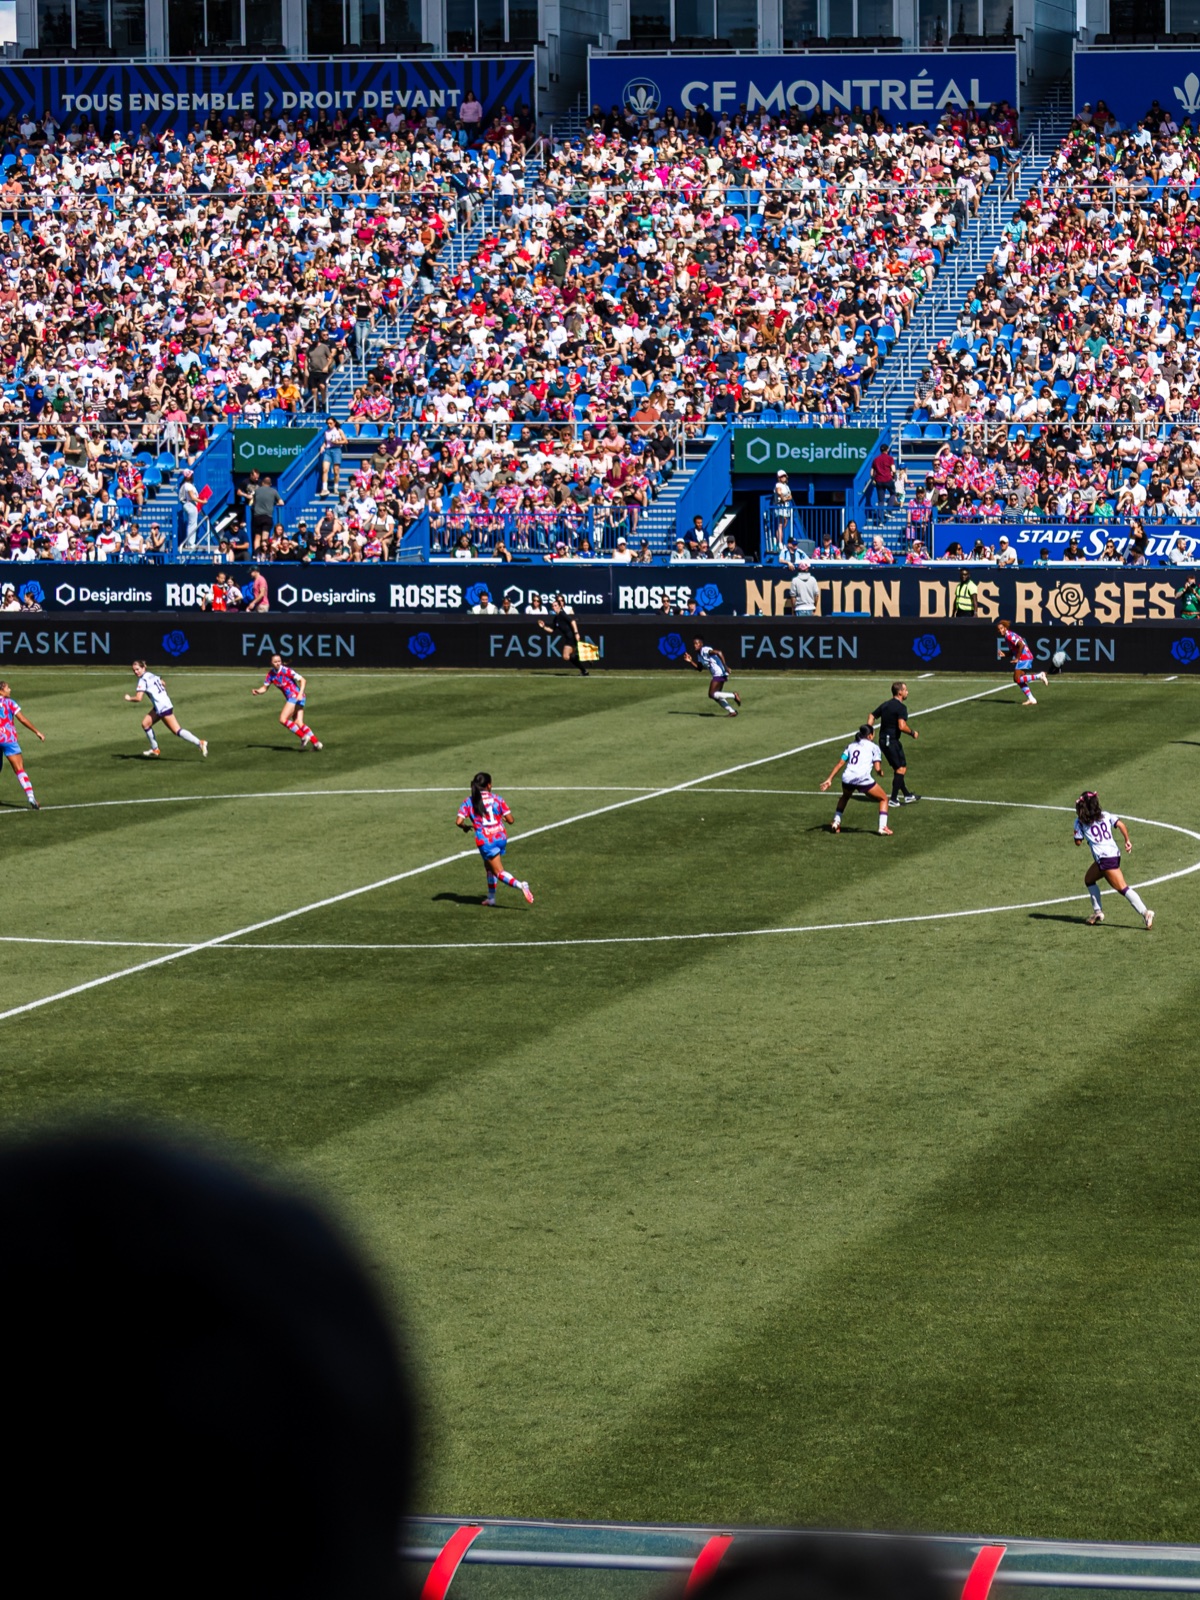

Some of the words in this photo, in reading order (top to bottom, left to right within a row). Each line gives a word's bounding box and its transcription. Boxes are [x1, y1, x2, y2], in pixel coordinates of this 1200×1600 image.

[282, 91, 357, 109] DROIT
[363, 89, 462, 109] DEVANT
[680, 81, 737, 112] CF
[746, 68, 992, 112] MONTRÉAL
[61, 94, 123, 112] TOUS
[129, 92, 255, 111] ENSEMBLE
[776, 442, 868, 463] Desjardins
[1016, 529, 1084, 544] STADE
[78, 587, 152, 602] Desjardins
[301, 589, 376, 604] Desjardins
[389, 584, 462, 608] ROSES
[0, 631, 111, 655] FASKEN
[242, 634, 356, 658] FASKEN
[489, 635, 605, 658] FASKN
[740, 635, 858, 660] FASKEN
[996, 637, 1116, 662] FSKEN
[850, 749, 861, 765] 8
[1090, 821, 1112, 843] 98
